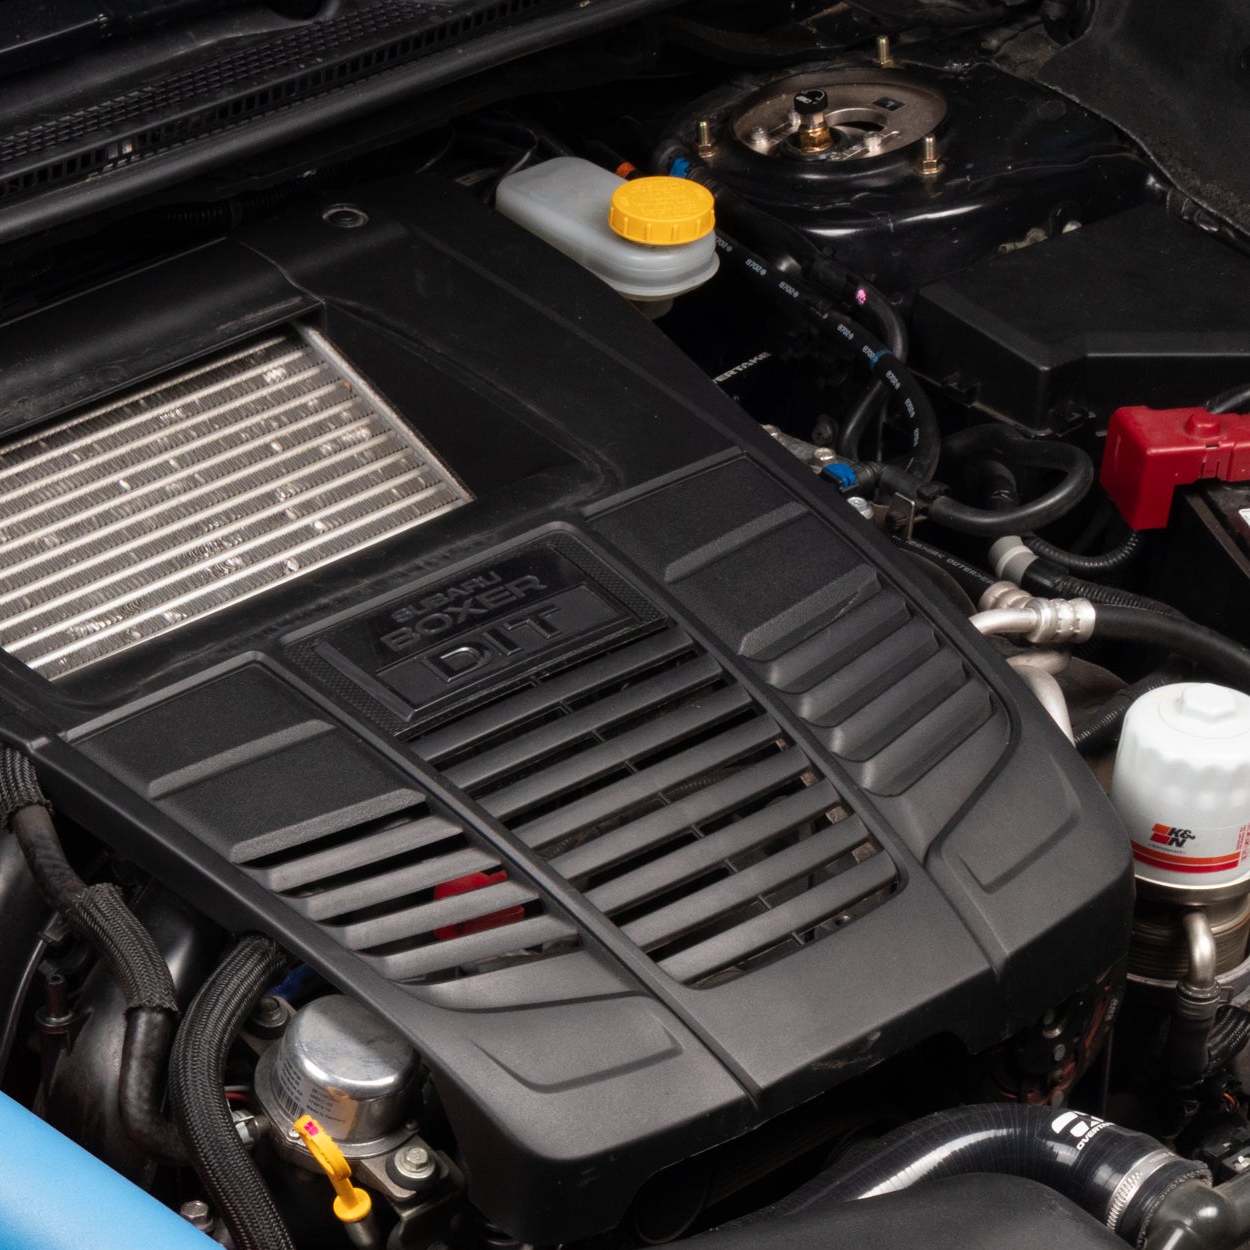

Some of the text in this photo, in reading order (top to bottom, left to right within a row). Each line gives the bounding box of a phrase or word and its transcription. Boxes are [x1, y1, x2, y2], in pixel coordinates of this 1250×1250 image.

[380, 574, 547, 650] BOXER
[391, 570, 502, 623] SUBARU
[421, 603, 563, 683] DIT
